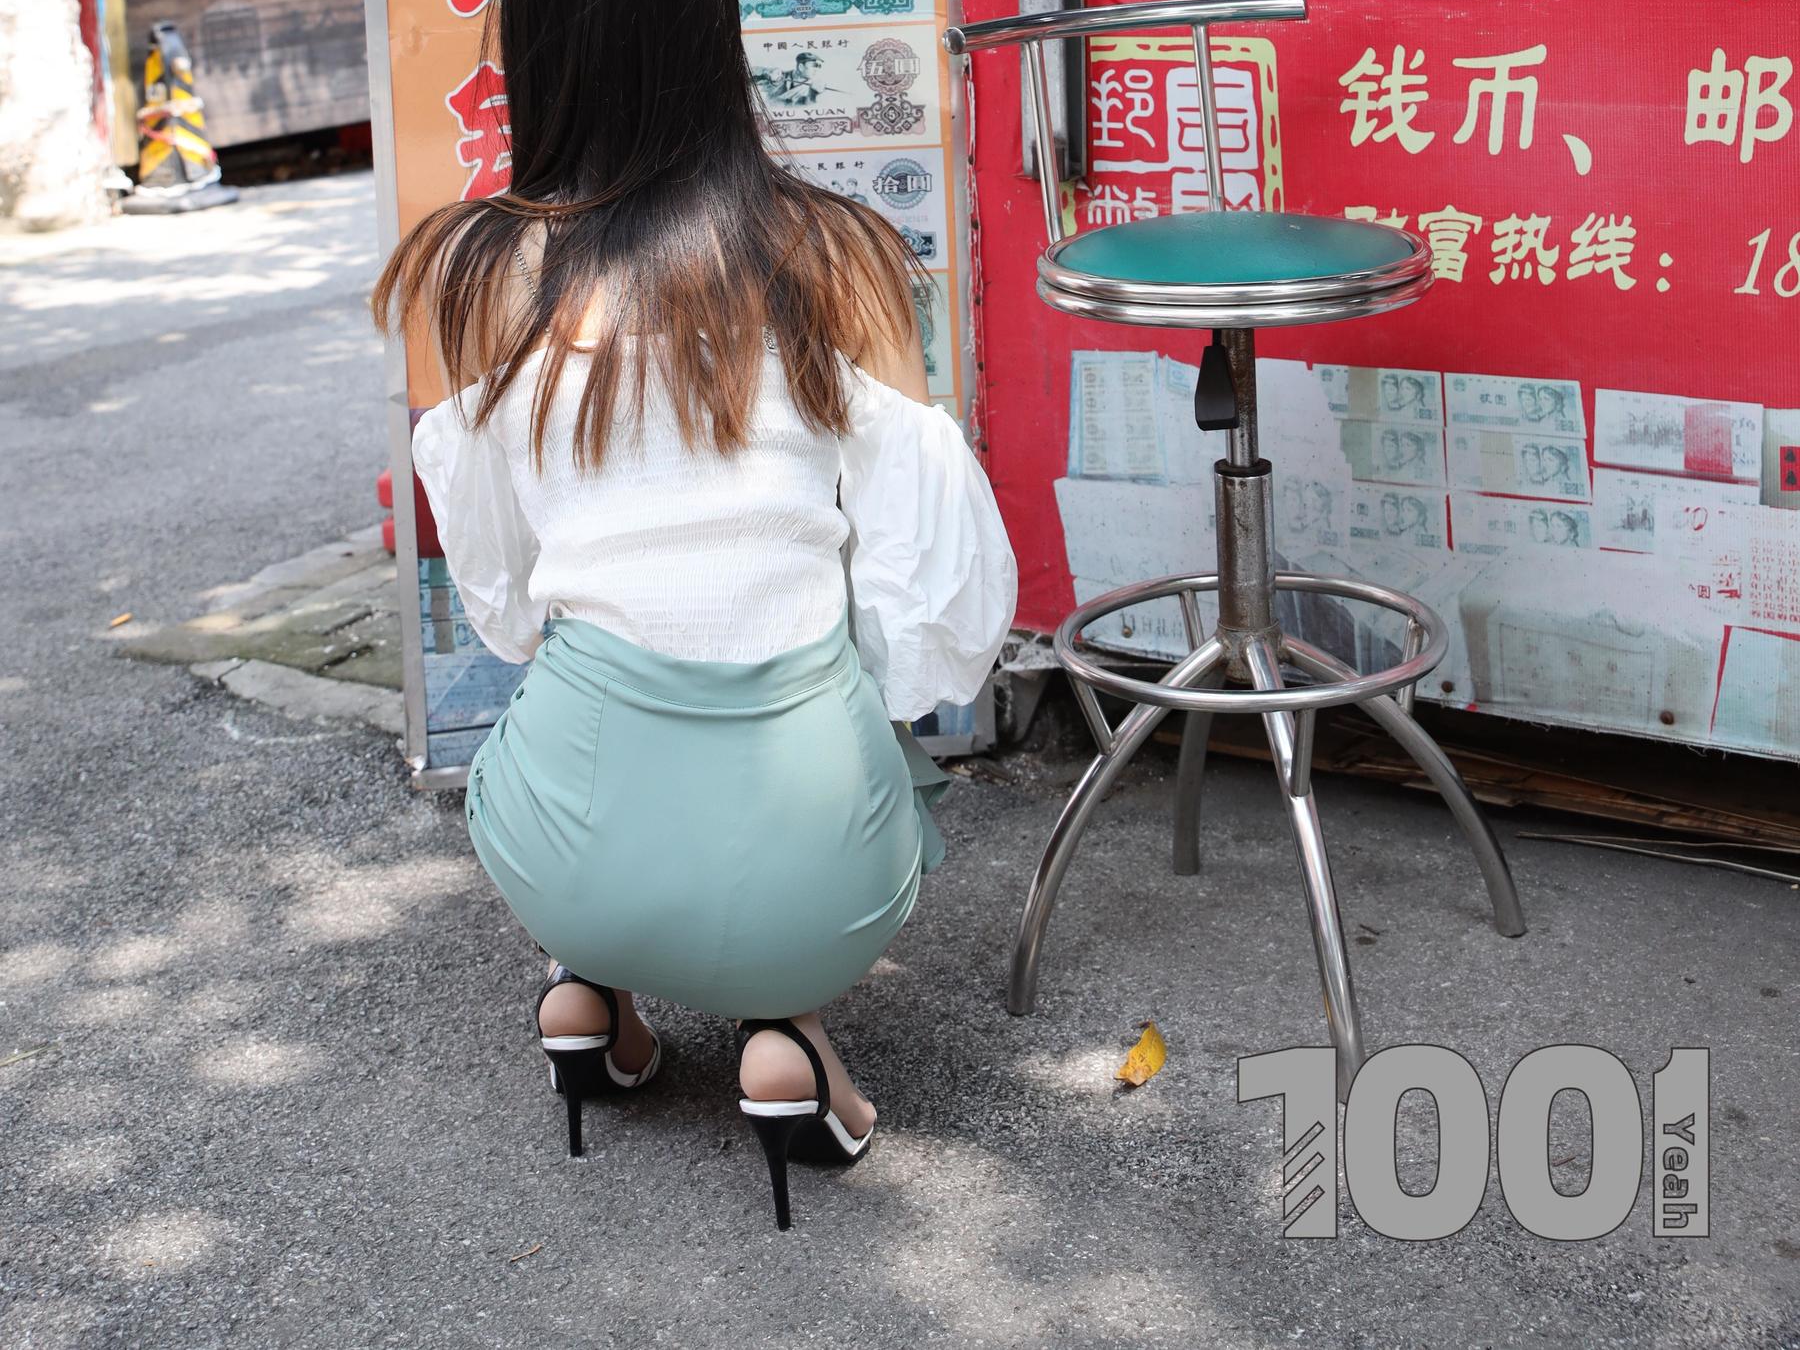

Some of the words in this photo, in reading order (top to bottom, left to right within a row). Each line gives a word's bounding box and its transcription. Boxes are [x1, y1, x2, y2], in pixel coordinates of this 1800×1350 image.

[772, 109, 796, 118] WU
[804, 107, 846, 117] YUAN
[888, 110, 896, 120] 5
[1344, 204, 1674, 293] 富热线：
